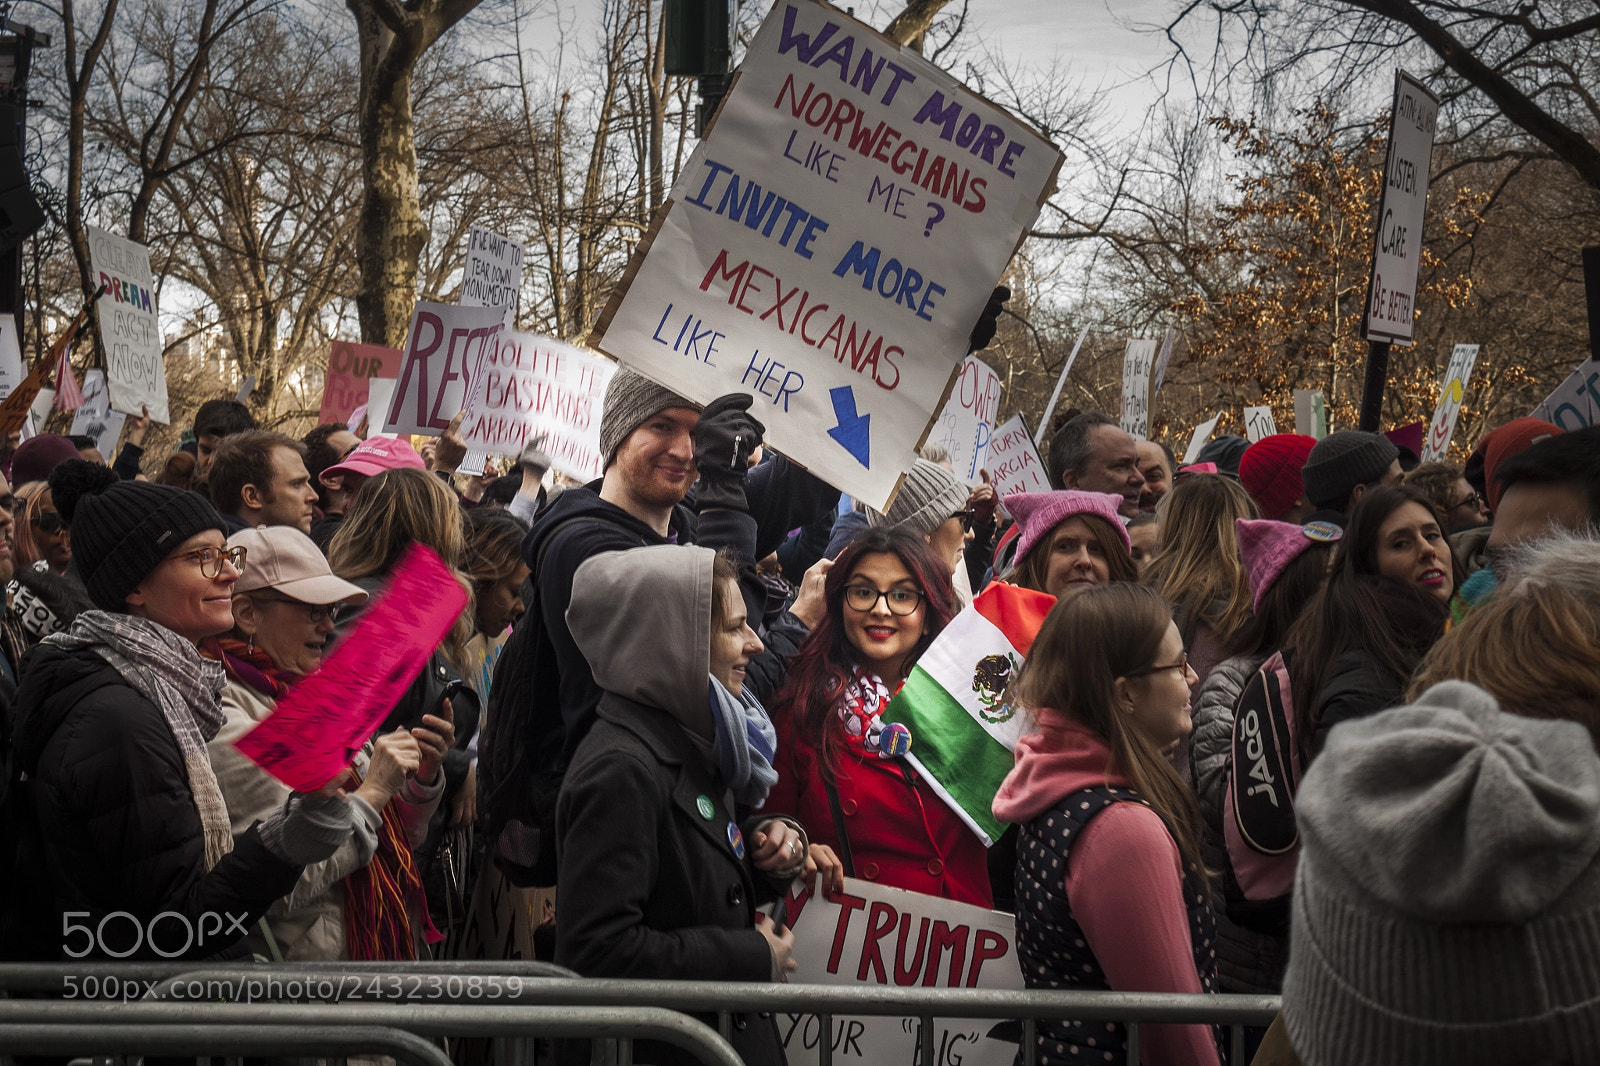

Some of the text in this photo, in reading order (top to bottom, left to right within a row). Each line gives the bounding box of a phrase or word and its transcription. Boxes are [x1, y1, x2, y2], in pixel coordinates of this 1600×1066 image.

[777, 5, 1026, 179] WANT MORE
[774, 74, 987, 213] NORWEGIANS
[784, 130, 846, 183] LIKE
[1389, 141, 1417, 197] LISTEN.
[471, 230, 479, 251] IF
[489, 233, 507, 260] WANT
[511, 244, 520, 266] TO
[685, 159, 946, 322] INVITE MORE
[1380, 208, 1406, 259] CARE.
[100, 271, 152, 314] DREAM
[463, 277, 516, 310] MONUMENTS
[472, 257, 512, 286] TEAR DOWN
[1373, 273, 1386, 320] BE
[114, 310, 151, 348] ACT
[699, 249, 905, 390] MEXICANAS
[112, 343, 158, 393] NOW
[333, 345, 382, 379] OUR
[652, 304, 804, 413] LIKE HER
[988, 426, 1027, 461] TURN
[826, 891, 1009, 989] TRUMP
